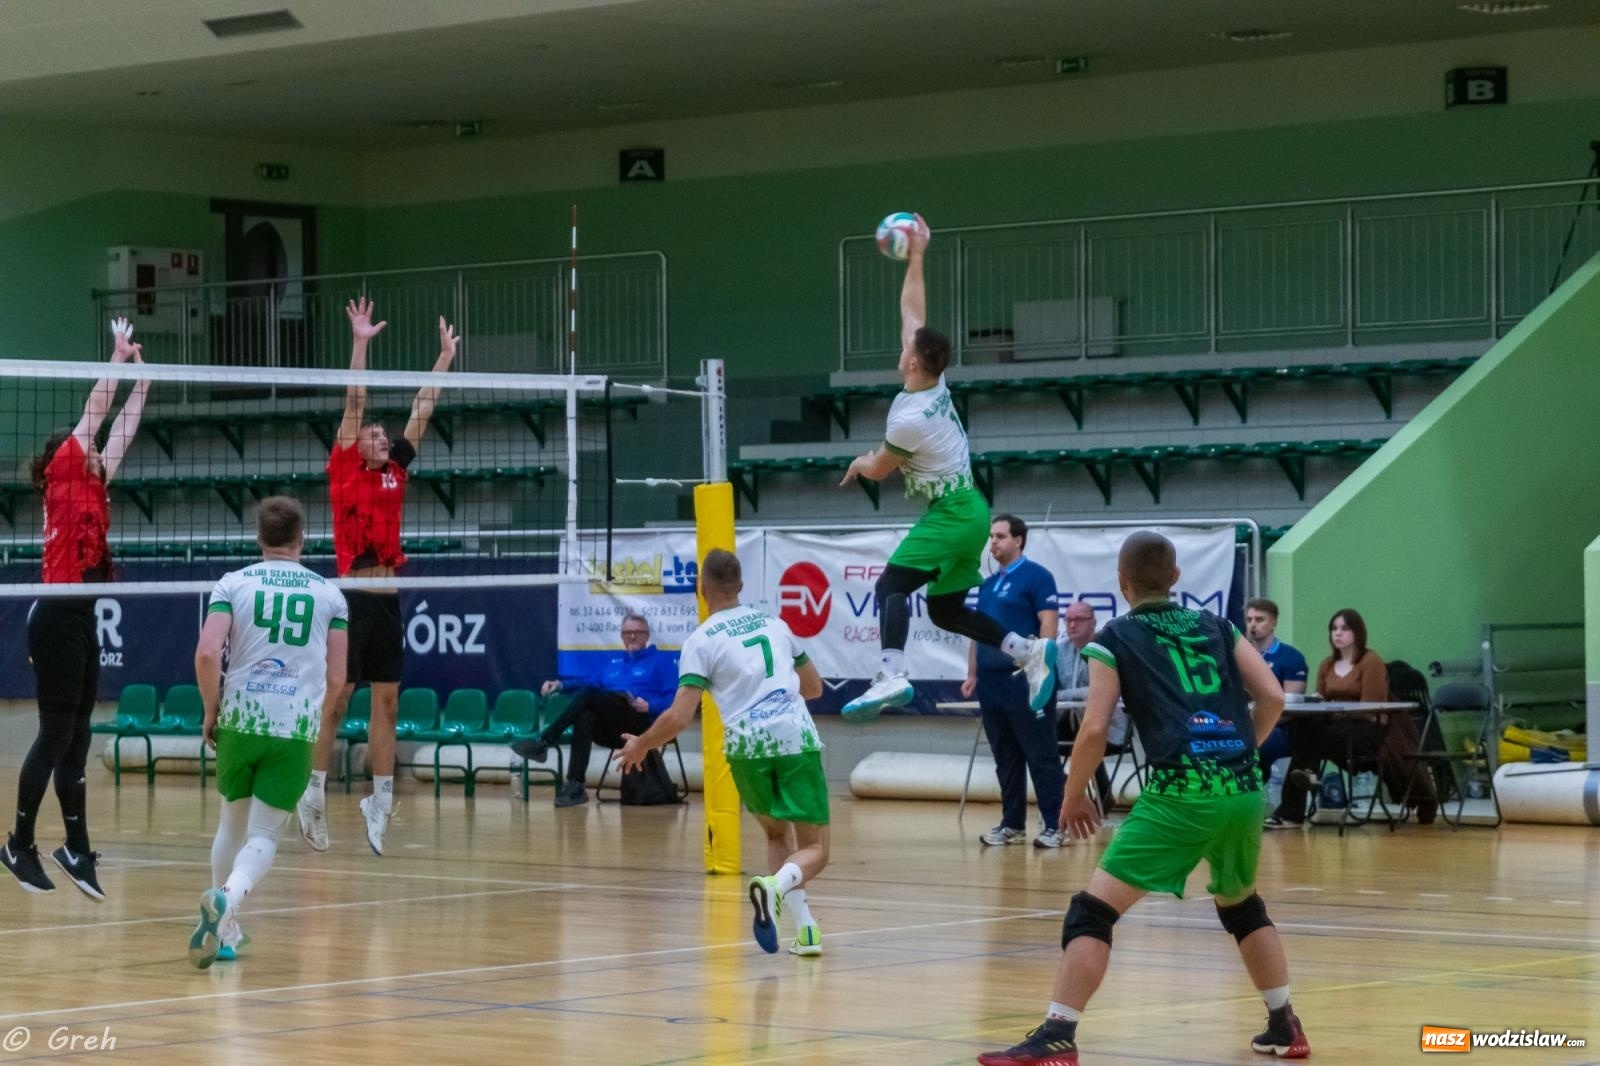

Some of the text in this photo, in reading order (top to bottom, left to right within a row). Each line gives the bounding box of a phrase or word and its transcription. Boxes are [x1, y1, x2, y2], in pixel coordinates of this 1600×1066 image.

[1467, 79, 1495, 100] B
[627, 159, 657, 177] A
[253, 590, 315, 647] 49
[402, 599, 486, 654] ÓRZ
[742, 634, 774, 679] 7
[1156, 635, 1221, 695] 15
